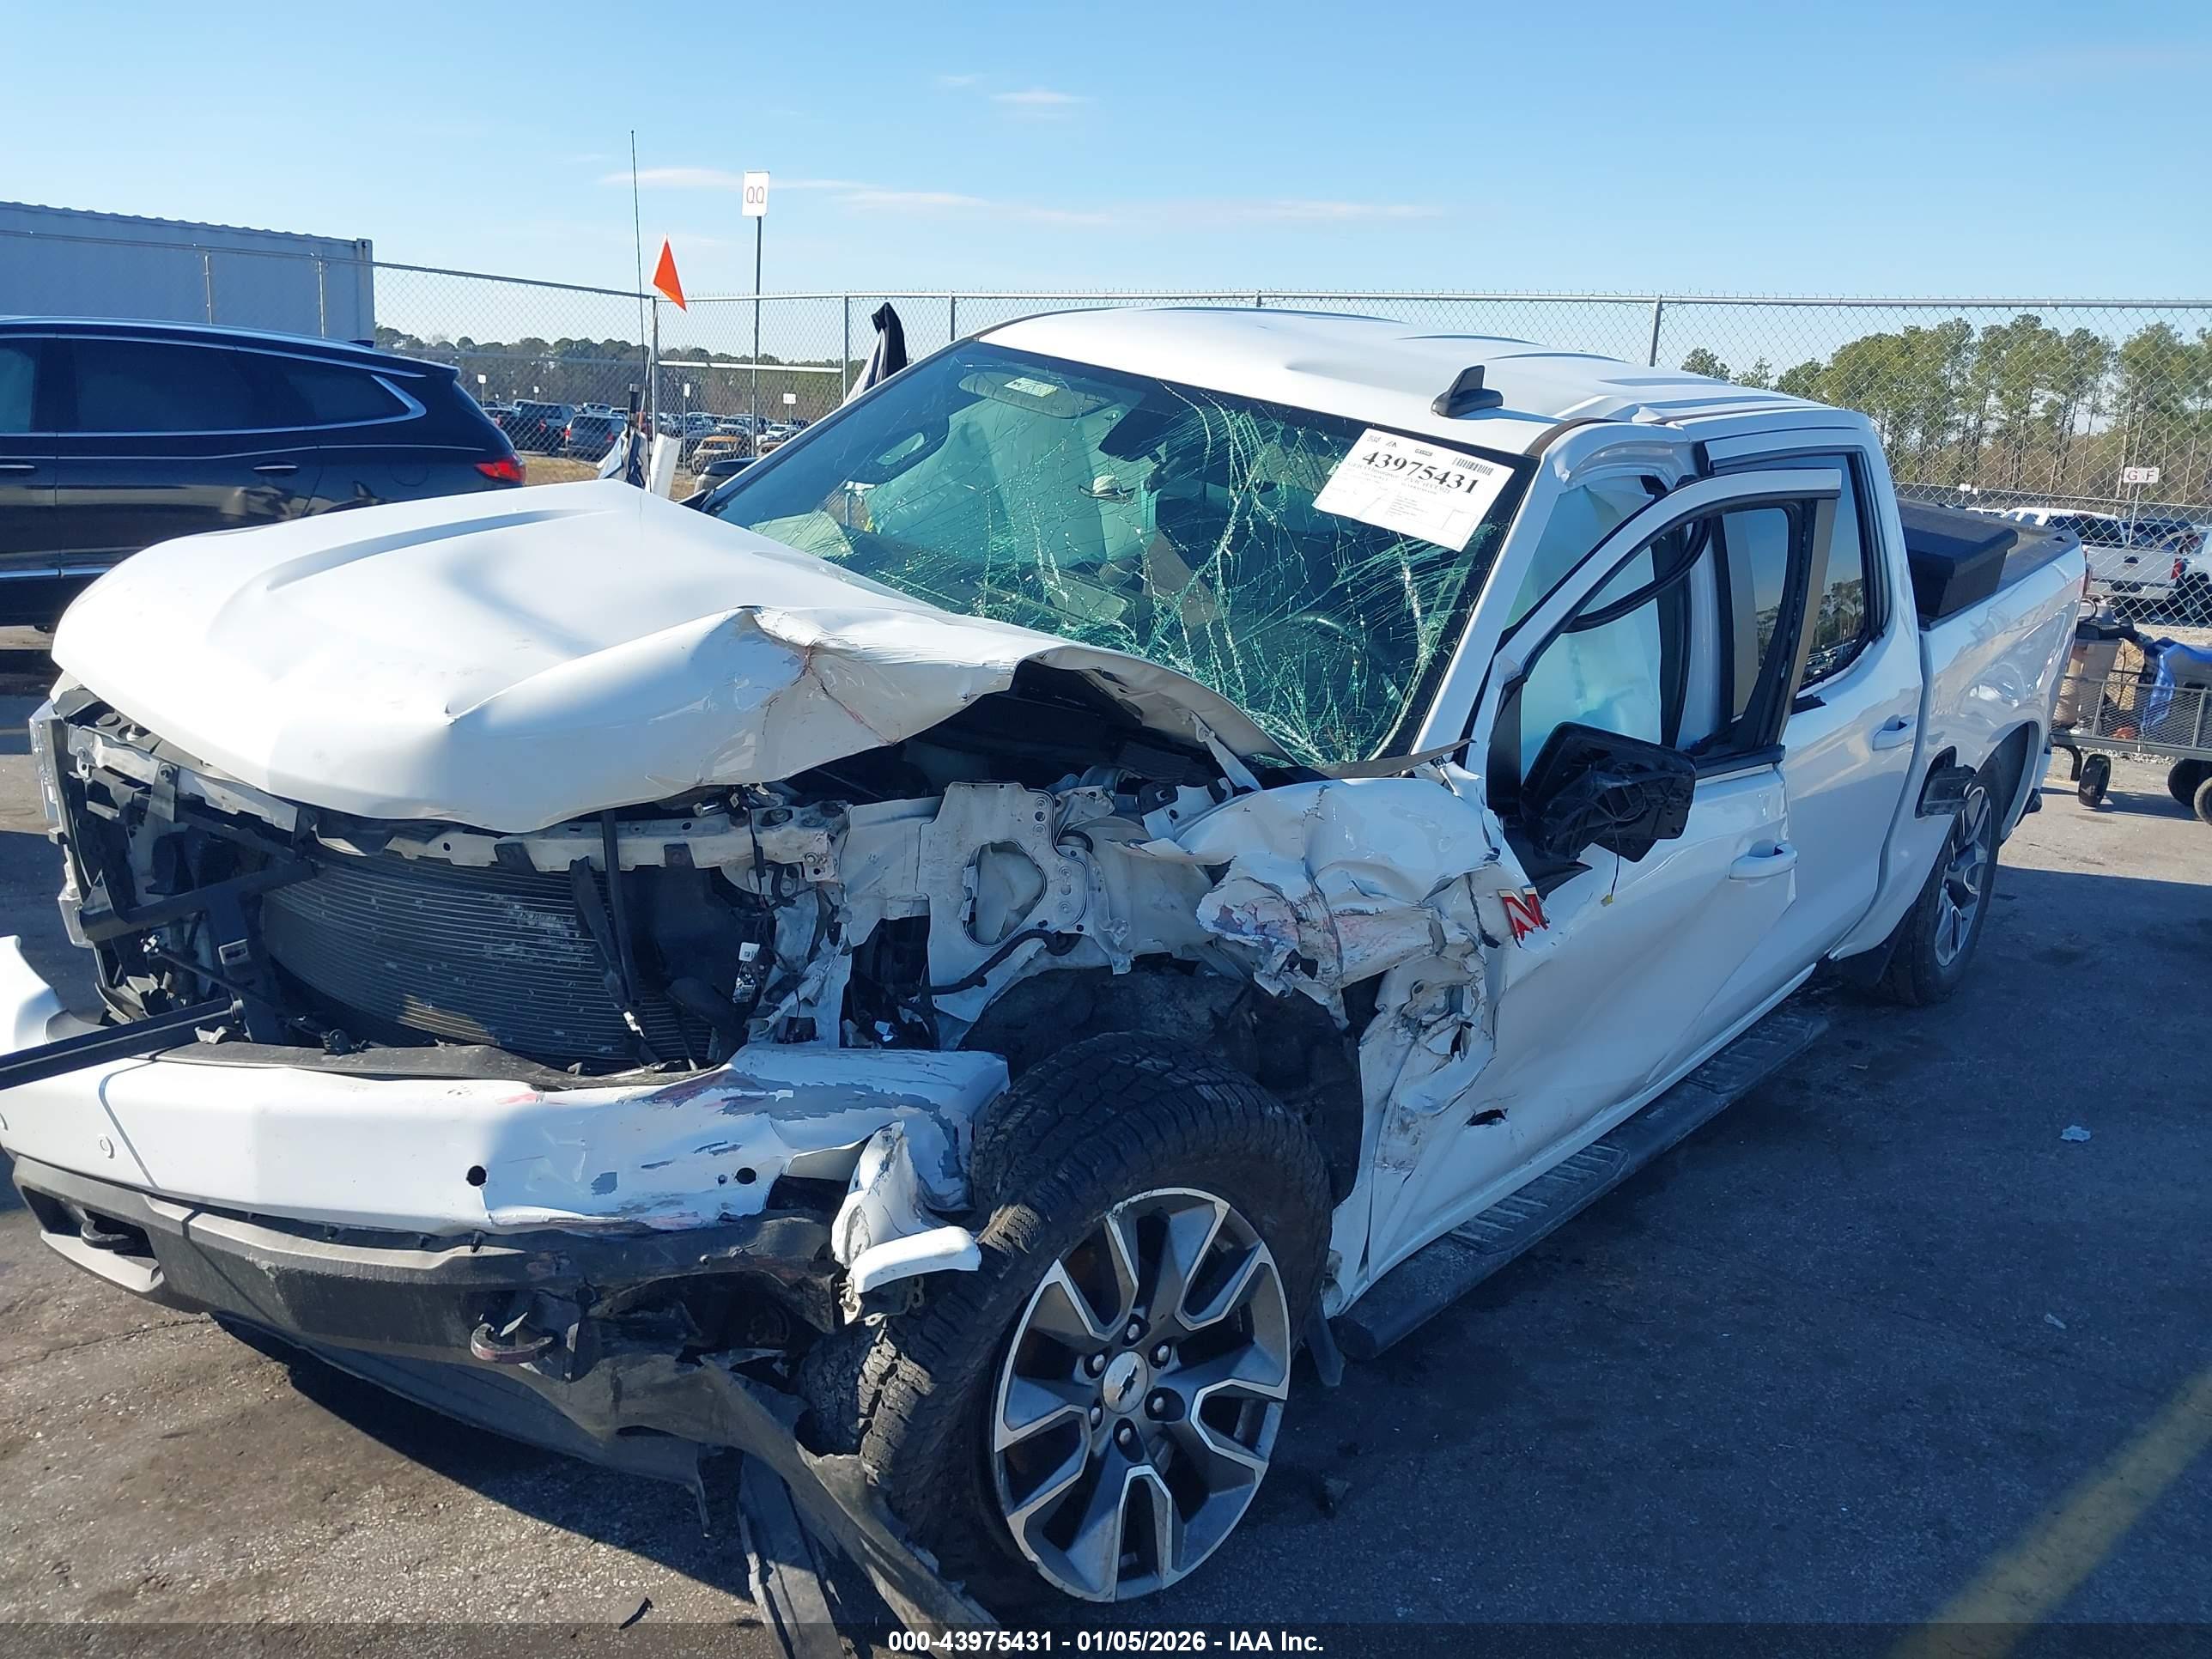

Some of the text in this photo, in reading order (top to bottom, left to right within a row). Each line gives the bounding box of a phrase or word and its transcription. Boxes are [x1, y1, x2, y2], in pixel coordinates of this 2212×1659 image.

[1363, 451, 1480, 494] 43975431
[2127, 470, 2155, 481] G F
